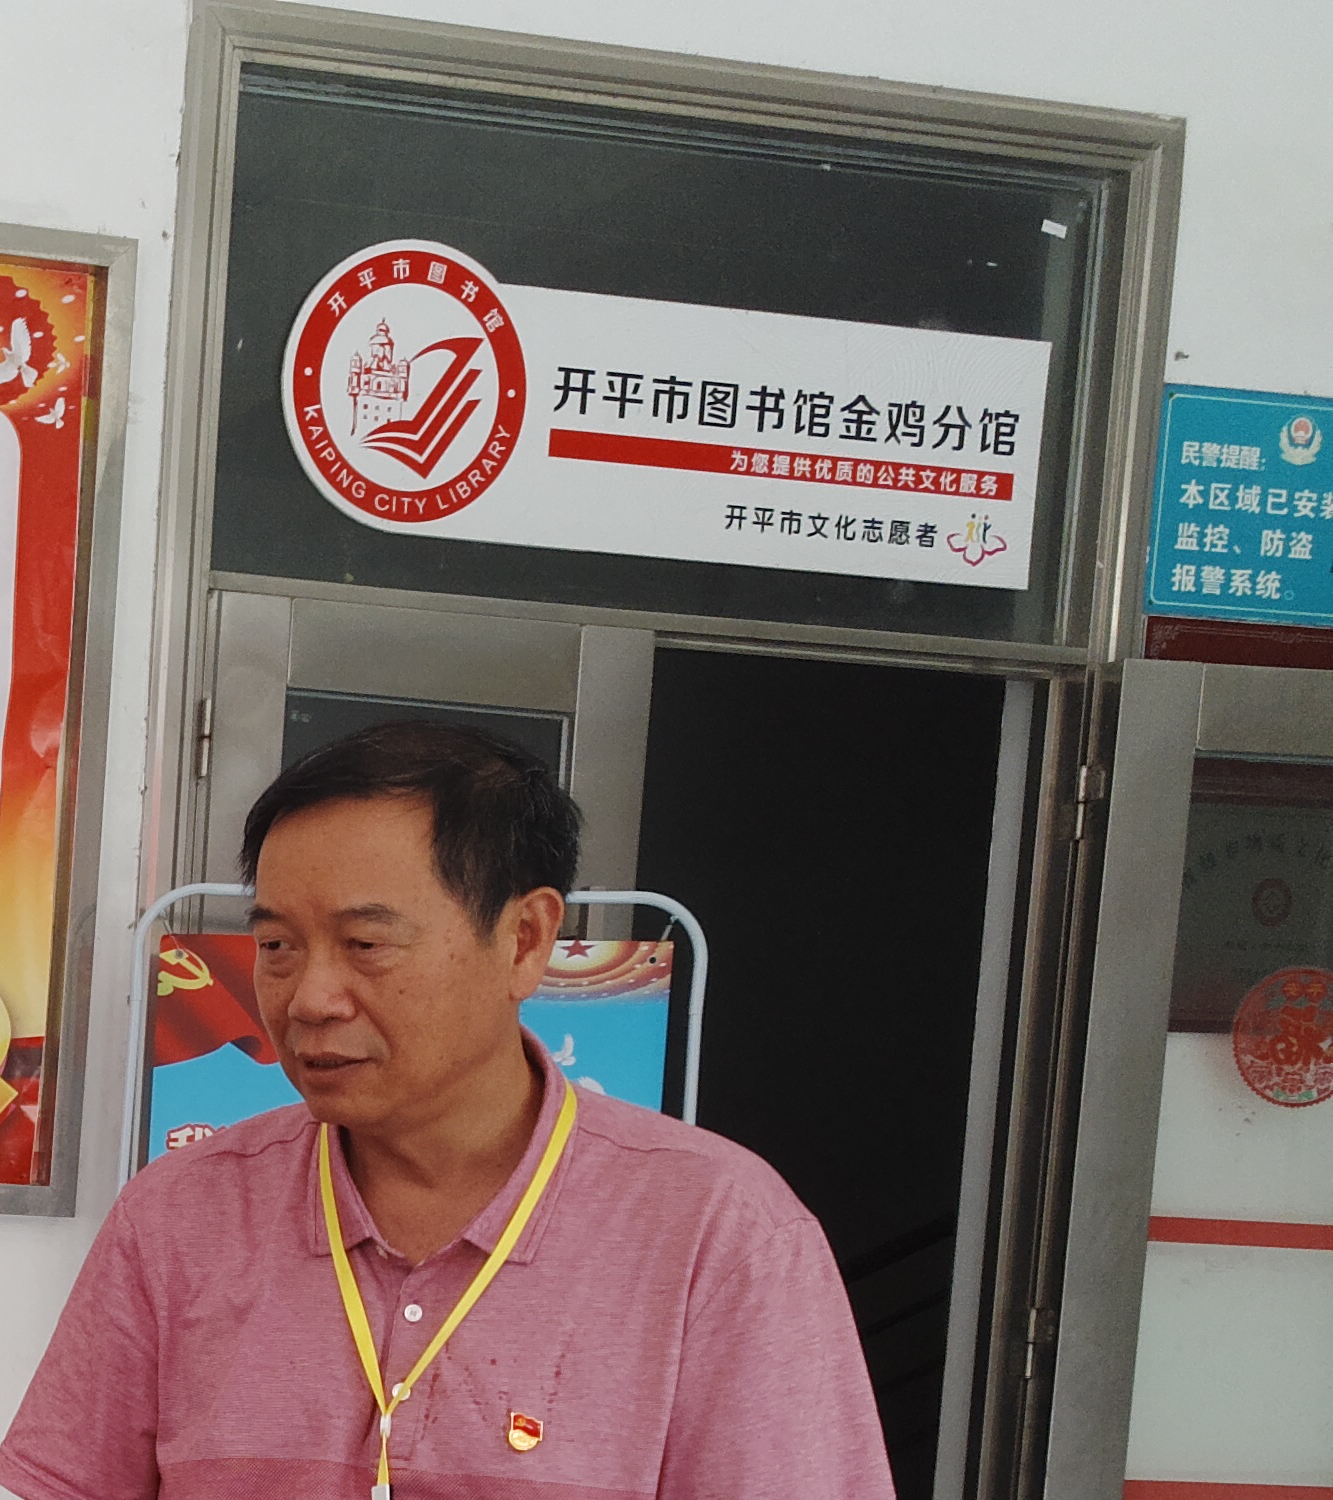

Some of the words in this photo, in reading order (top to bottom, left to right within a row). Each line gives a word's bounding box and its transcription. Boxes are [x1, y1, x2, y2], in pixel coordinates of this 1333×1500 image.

[326, 258, 505, 336] 开平市图书馆
[553, 365, 1021, 458] 开平市图书馆金鸡分馆
[303, 403, 367, 501] KAIPING
[374, 492, 426, 516] CITY
[435, 422, 512, 512] LIBRARY
[729, 450, 1000, 497] 为您提供优质的公共文化服务
[724, 503, 938, 549] 开平市文化志愿者
[1174, 522, 1314, 560] 监控、防盗
